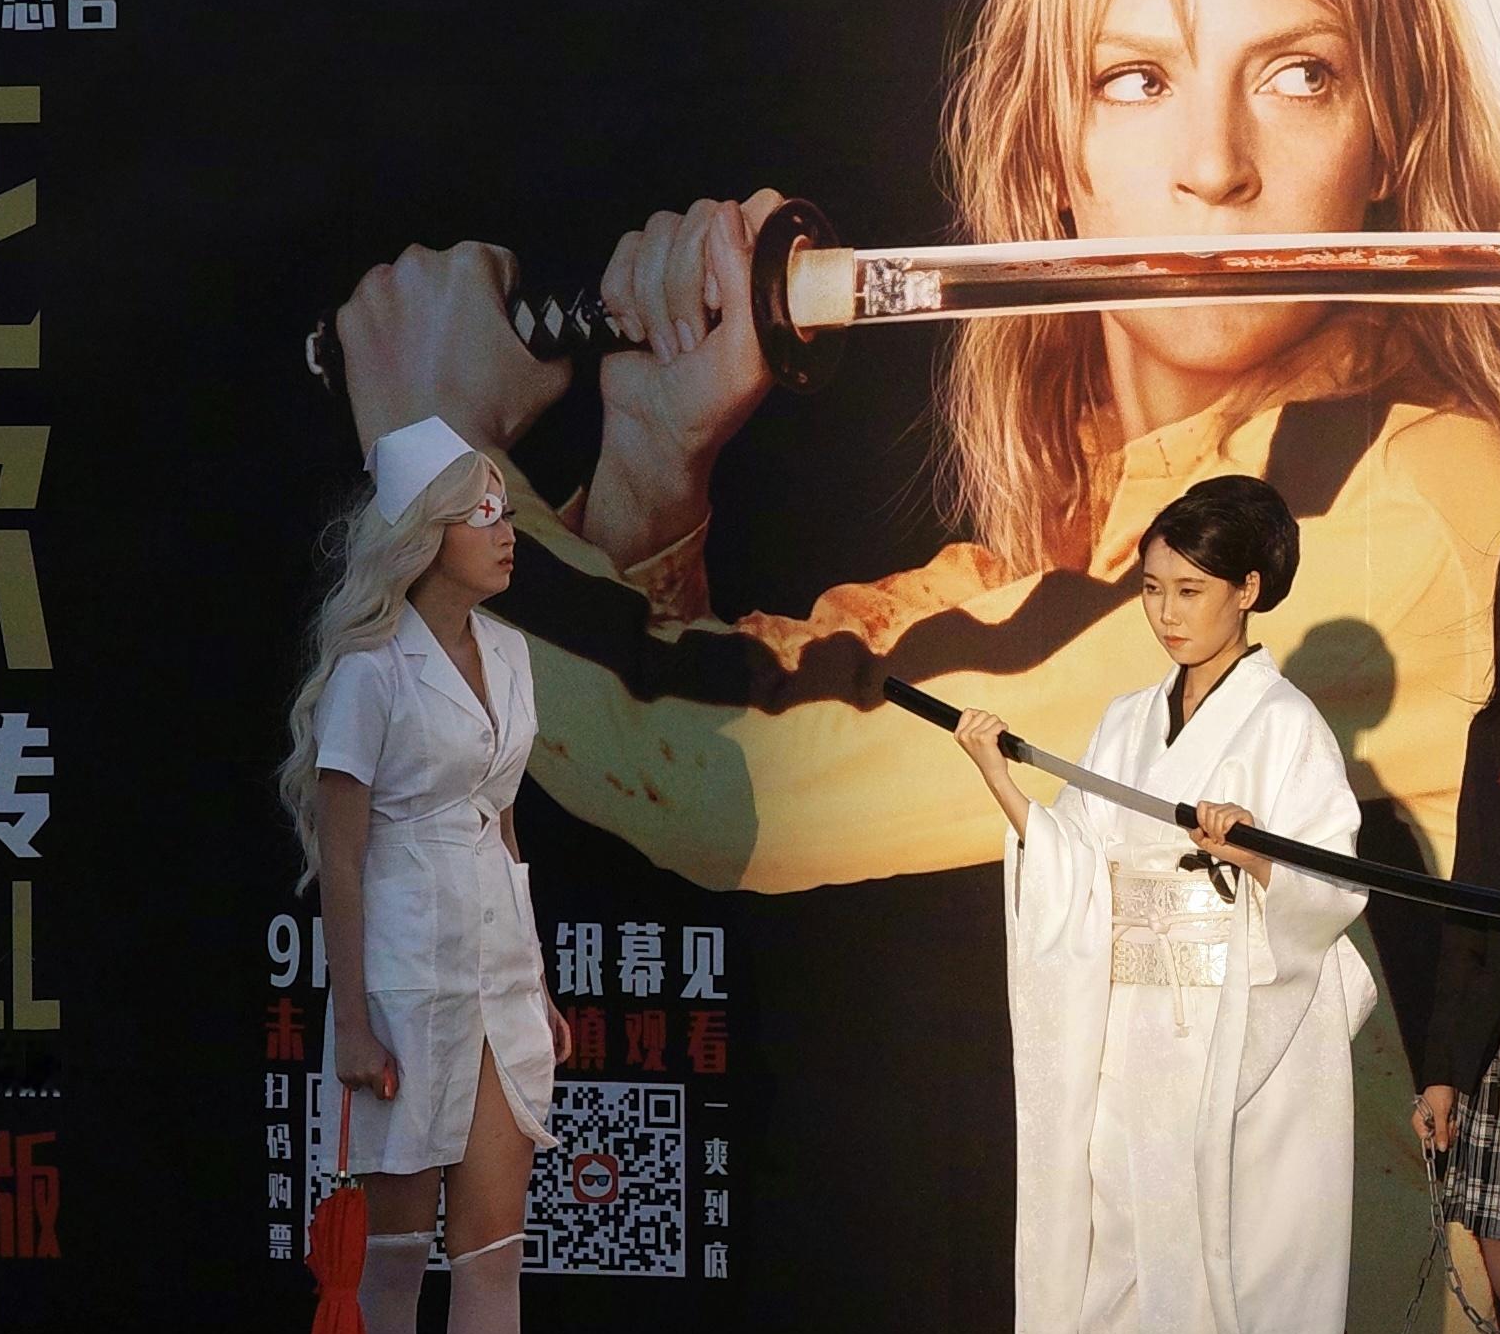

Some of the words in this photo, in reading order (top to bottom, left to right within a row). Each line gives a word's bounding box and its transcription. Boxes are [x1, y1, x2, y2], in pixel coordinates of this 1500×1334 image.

[264, 1072, 293, 1261] 扫码购票
[703, 1101, 730, 1281] 一爽到底
